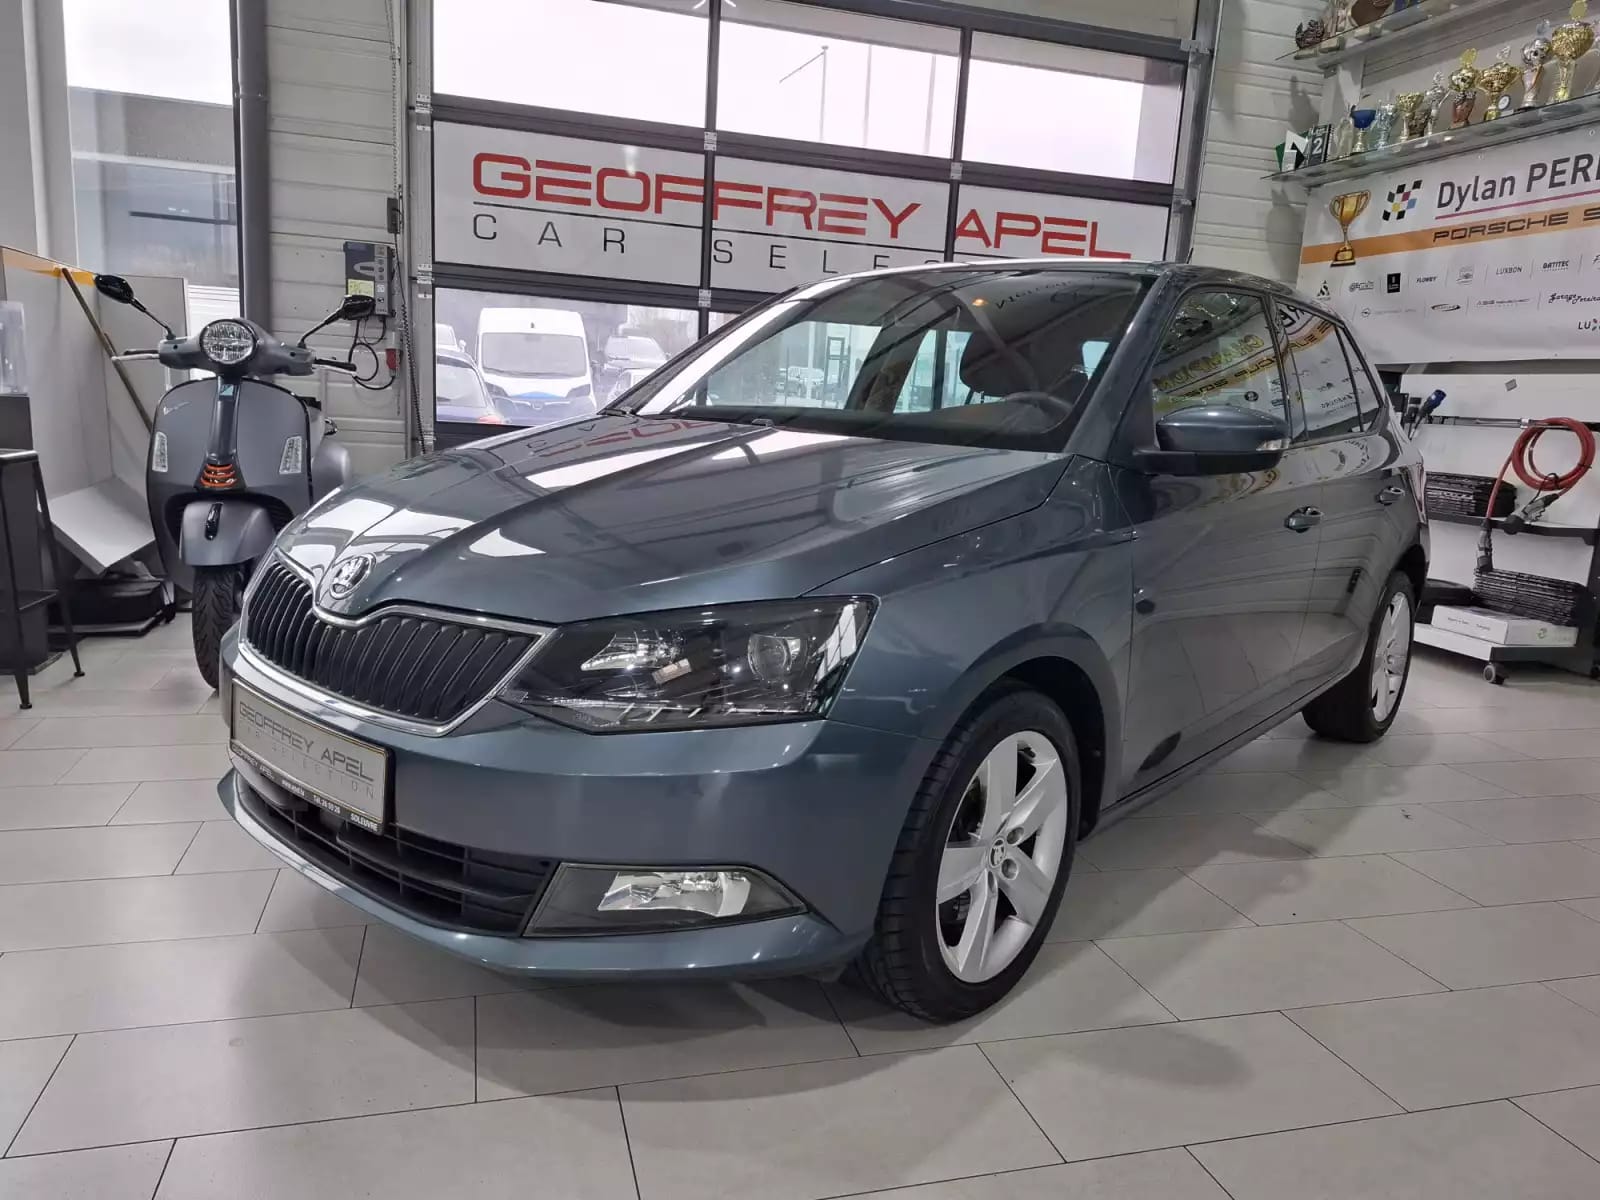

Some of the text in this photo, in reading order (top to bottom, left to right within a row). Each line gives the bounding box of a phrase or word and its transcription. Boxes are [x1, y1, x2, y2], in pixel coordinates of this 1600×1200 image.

[472, 152, 1132, 260] GEOFFREY APEL
[1437, 153, 1600, 212] Dylan PER
[473, 213, 626, 254] CAR
[1433, 211, 1569, 243] PORSCHE
[239, 701, 374, 782] GEOFFREY APEL
